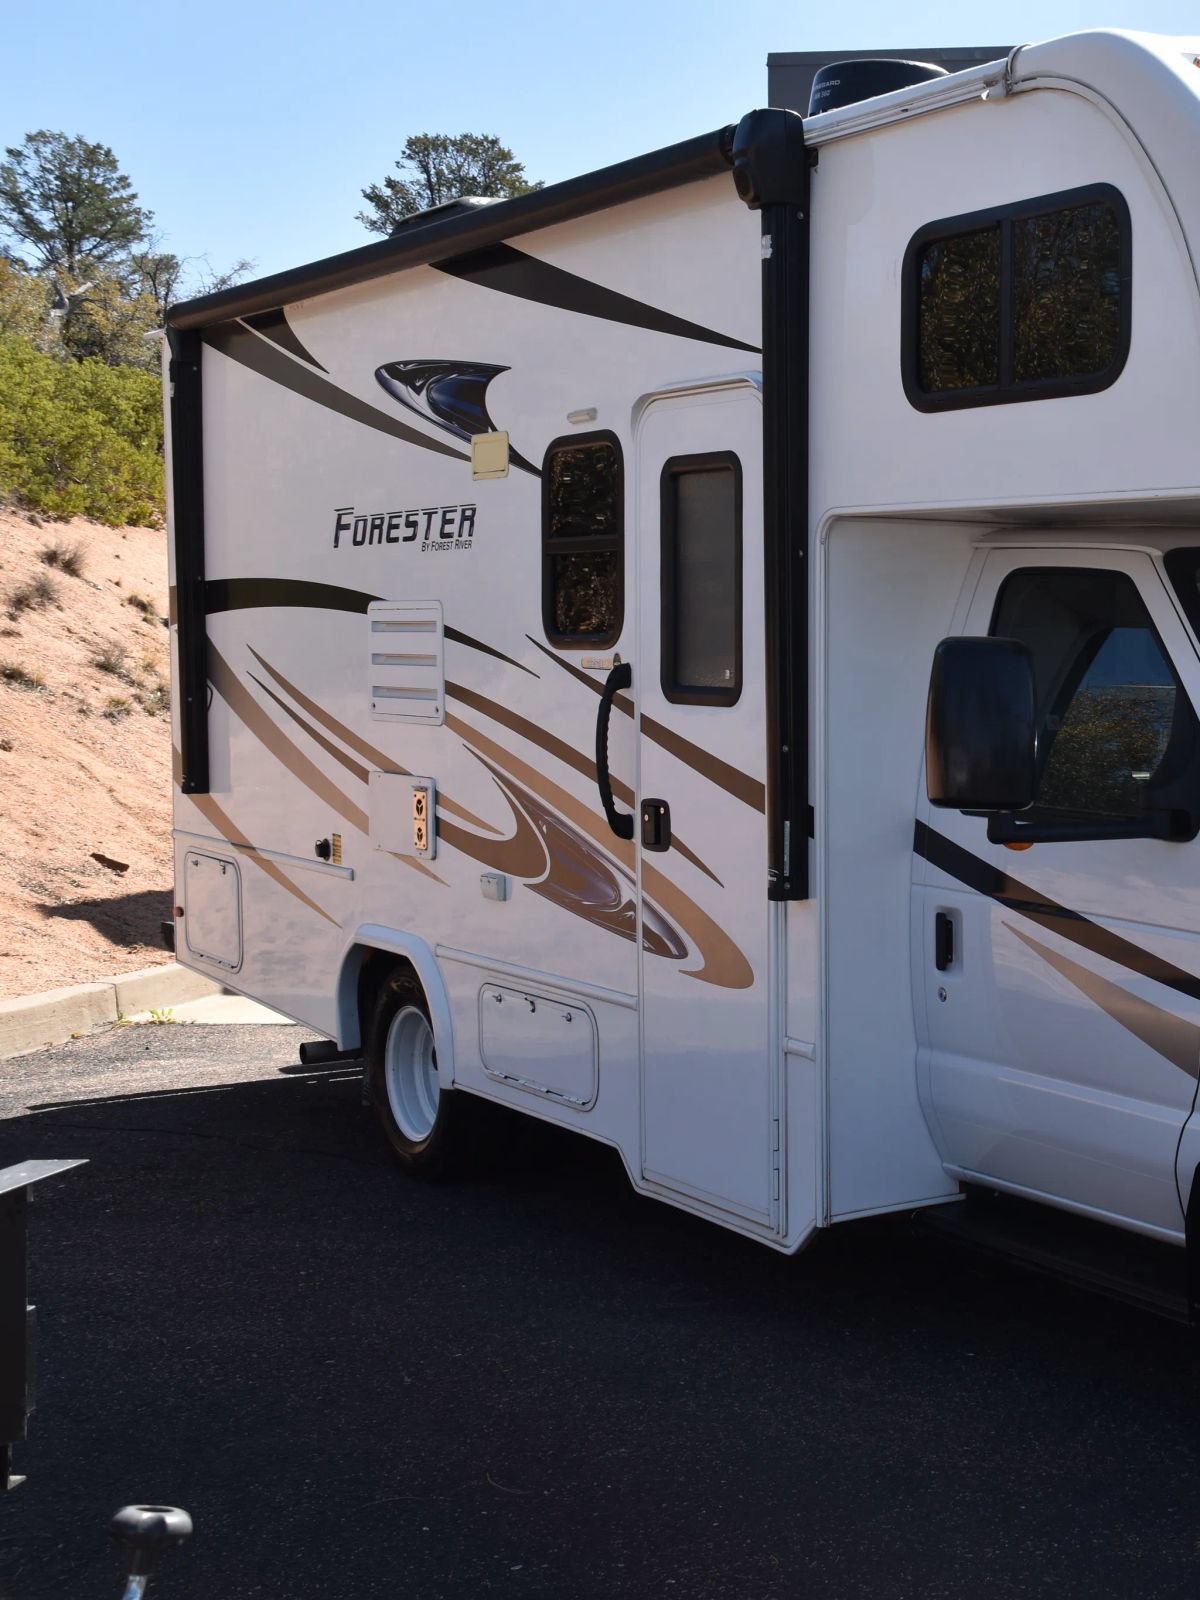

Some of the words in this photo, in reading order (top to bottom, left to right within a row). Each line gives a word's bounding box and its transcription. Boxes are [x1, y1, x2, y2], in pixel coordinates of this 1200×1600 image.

[333, 504, 476, 548] FORESTER
[430, 540, 453, 551] FOREST
[454, 538, 472, 550] RIVER
